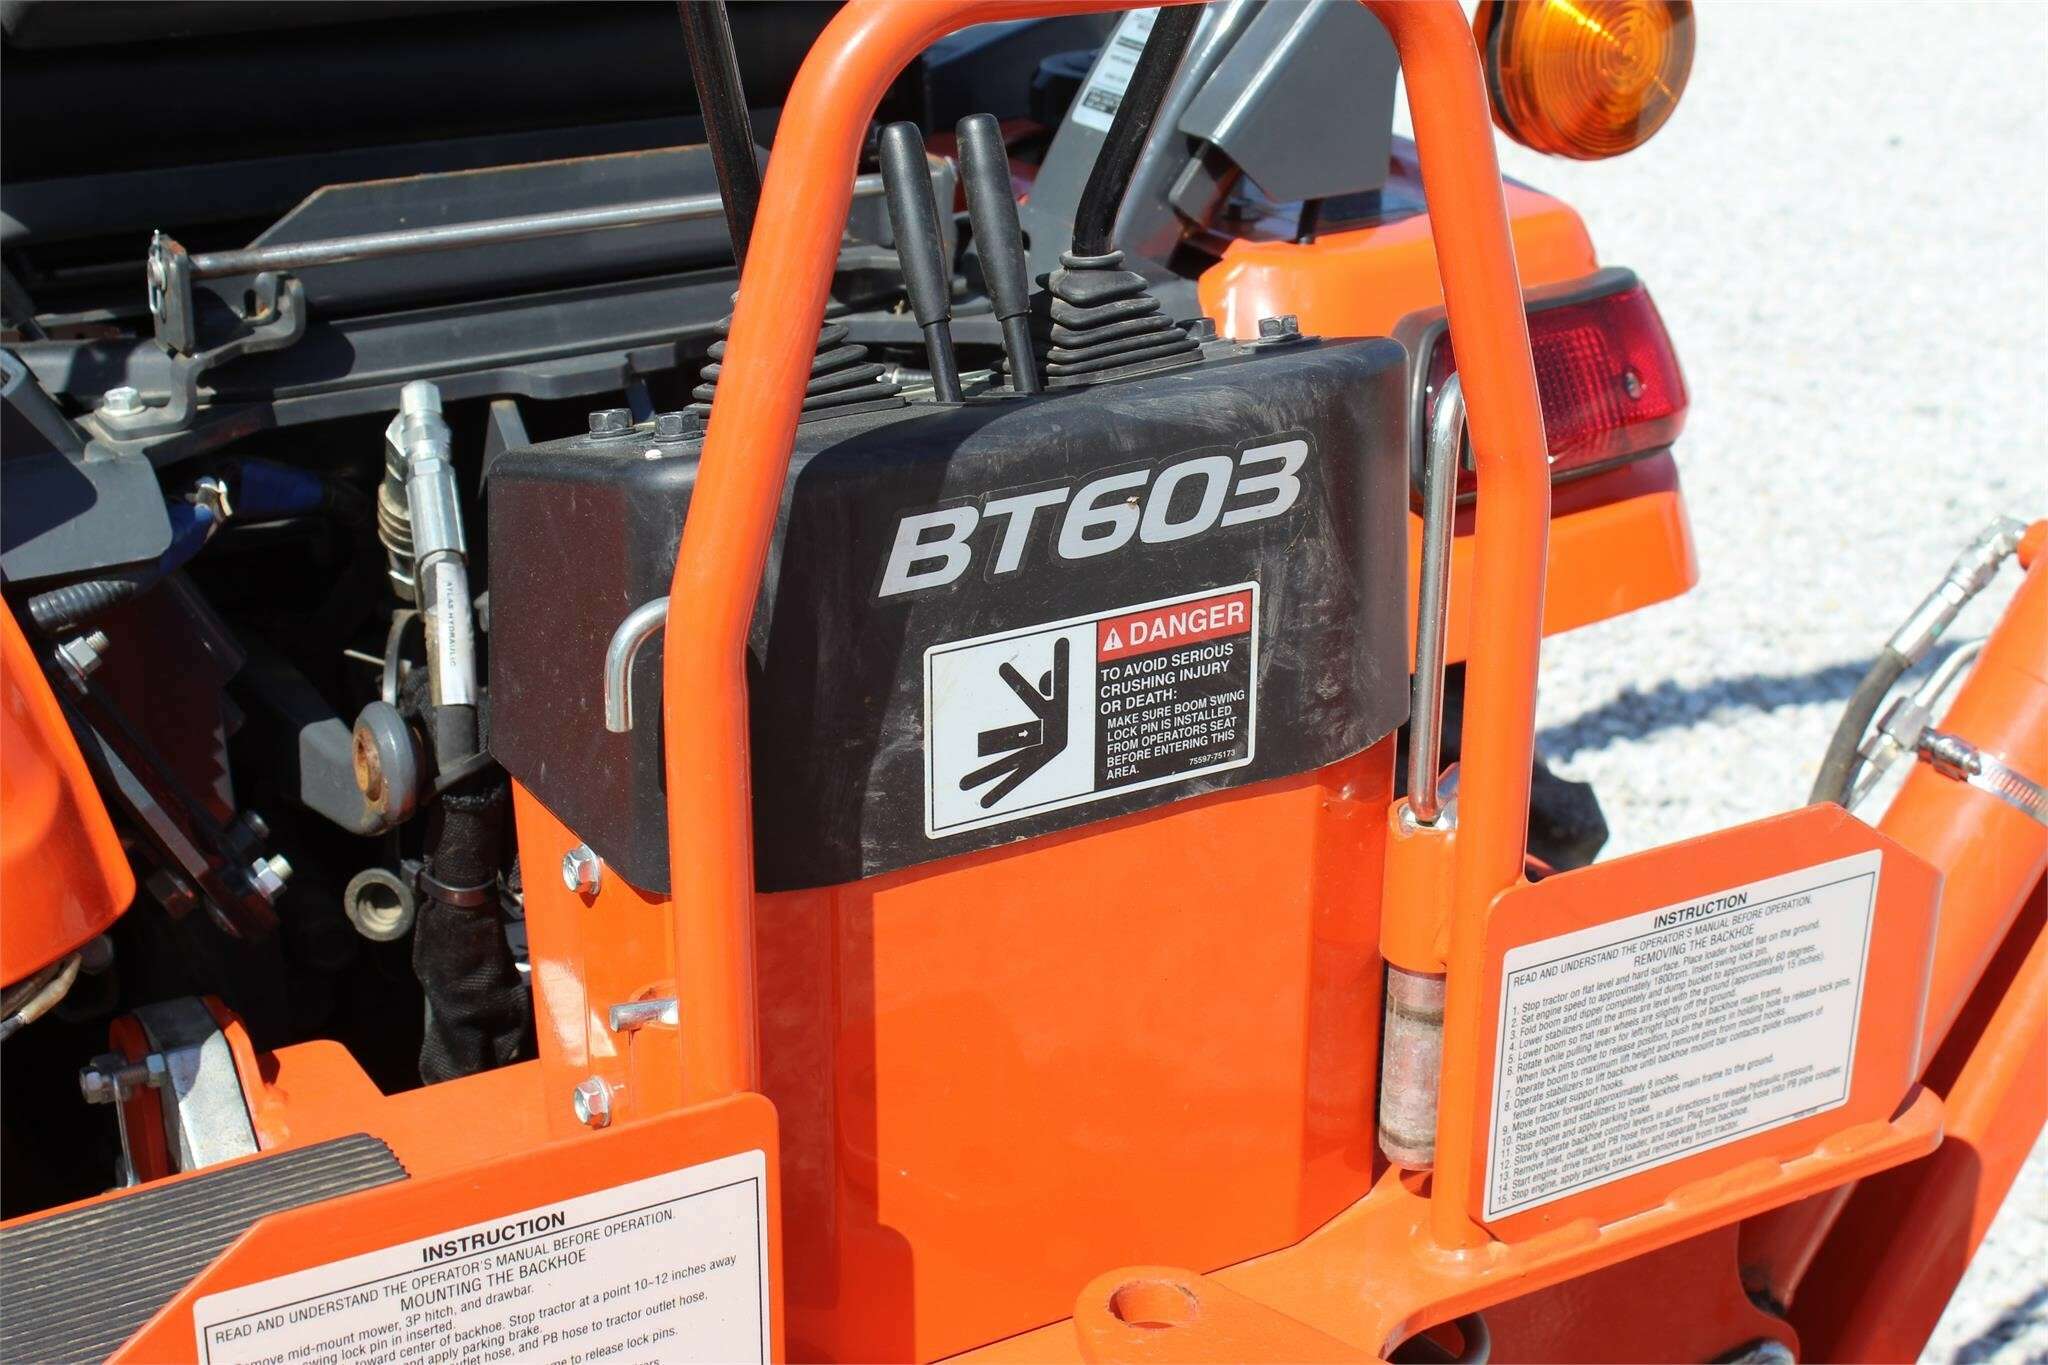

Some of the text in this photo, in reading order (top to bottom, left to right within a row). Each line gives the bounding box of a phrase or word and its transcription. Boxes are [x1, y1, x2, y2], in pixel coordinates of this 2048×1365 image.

[878, 440, 1308, 598] BT603
[446, 612, 456, 668] HYDRAULIC
[1130, 600, 1244, 645] DANGER
[1100, 642, 1233, 681] TO AVOID SERIOUS
[1100, 659, 1229, 698] CRUSHING INJURY
[1100, 687, 1177, 714] OR DEATH:
[1107, 689, 1244, 729] MAKE SURE BOOM SWING
[1107, 704, 1232, 742] LOCK PIN IS INSTALLED
[1106, 728, 1234, 767] BEFORE ENTERING THIS
[1107, 715, 1237, 754] FROM OPERATORS SEAT
[1106, 764, 1139, 780] AREA.
[1653, 891, 1747, 928] INSTRUCTION
[1513, 895, 1812, 986] READ AND UNDERSTAND THE OPERATOR'S MANUAL BEFORE OPERATION.
[1633, 923, 1754, 967] REMOVING THE BACKHOE
[1520, 1013, 1534, 1025] Set
[1535, 1005, 1562, 1020] engine
[1563, 996, 1586, 1012] speed
[1588, 995, 1596, 1005] to
[1597, 980, 1651, 1002] approximately
[1691, 961, 1713, 974] Insert
[1713, 955, 1736, 968] swing
[1738, 950, 1753, 960] lock
[1521, 1000, 1540, 1013] Stop
[1542, 992, 1568, 1006] tractor
[1569, 988, 1580, 998] on
[1582, 983, 1594, 995] flat
[1596, 977, 1614, 990] level
[1614, 972, 1630, 985] and
[1631, 966, 1649, 980] hard
[1682, 953, 1703, 965] Place
[1704, 946, 1728, 960] loader
[1729, 938, 1754, 953] bucket
[1755, 934, 1767, 945] flat
[1768, 932, 1778, 941] on
[1779, 928, 1791, 938] the
[1519, 1023, 1537, 1036] Fold
[1538, 1017, 1561, 1031] boom
[1562, 1010, 1577, 1024] and
[1579, 1004, 1604, 1019] dipper
[1605, 991, 1647, 1011] completely
[1647, 986, 1662, 999] and
[1663, 981, 1686, 994] dump
[1687, 972, 1712, 987] bucket
[1713, 971, 1722, 980] to
[1722, 955, 1774, 978] approximately
[1511, 1118, 1533, 1131] Move
[1534, 1110, 1560, 1124] tractor
[1562, 1098, 1592, 1116] forward
[1592, 1082, 1646, 1107] approximately
[1647, 1079, 1653, 1089] 8
[1510, 1188, 1529, 1200] Stop
[1559, 1170, 1581, 1185] apply
[1582, 1161, 1610, 1179] parking
[1636, 1147, 1650, 1159] and
[1651, 1139, 1679, 1154] remove
[1680, 1134, 1693, 1144] key
[1695, 1128, 1712, 1139] from
[422, 1210, 564, 1262] INSTRUCTION
[215, 1208, 675, 1344] READ AND UNDERSTAND THE OPERATOR'S MANUAL BEFORE OPERATION.
[400, 1248, 585, 1311] MOUNTING THE BACKHOE
[288, 1333, 353, 1359] mid-mount
[359, 1322, 400, 1339] mower,
[406, 1313, 420, 1327] 3P
[425, 1306, 455, 1321] hitch,
[461, 1297, 481, 1311] and
[485, 1285, 532, 1304] drawbar.
[399, 1340, 435, 1358] center
[439, 1333, 450, 1346] of
[454, 1321, 504, 1342] backhoe.
[509, 1312, 535, 1327] Stop
[538, 1300, 575, 1318] tractor
[579, 1295, 589, 1307] at
[593, 1294, 599, 1303] a
[602, 1284, 630, 1302] point
[671, 1263, 706, 1280] inches
[709, 1254, 736, 1270] away
[484, 1348, 513, 1359] hose,
[518, 1338, 538, 1352] and
[543, 1332, 557, 1344] PB
[562, 1325, 587, 1339] hose
[592, 1321, 602, 1330] to
[606, 1310, 640, 1326] tractor
[645, 1298, 674, 1315] outlet
[679, 1292, 707, 1305] hose,
[342, 1345, 365, 1358] lock
[370, 1340, 387, 1354] pin
[392, 1335, 402, 1346] in
[406, 1319, 455, 1340] inserted.
[428, 1348, 456, 1364] apply
[462, 1335, 504, 1356] parking
[508, 1326, 541, 1340] brake.
[571, 1355, 582, 1364] to
[586, 1344, 624, 1360] release
[628, 1335, 649, 1348] lock
[654, 1326, 678, 1344] pins.
